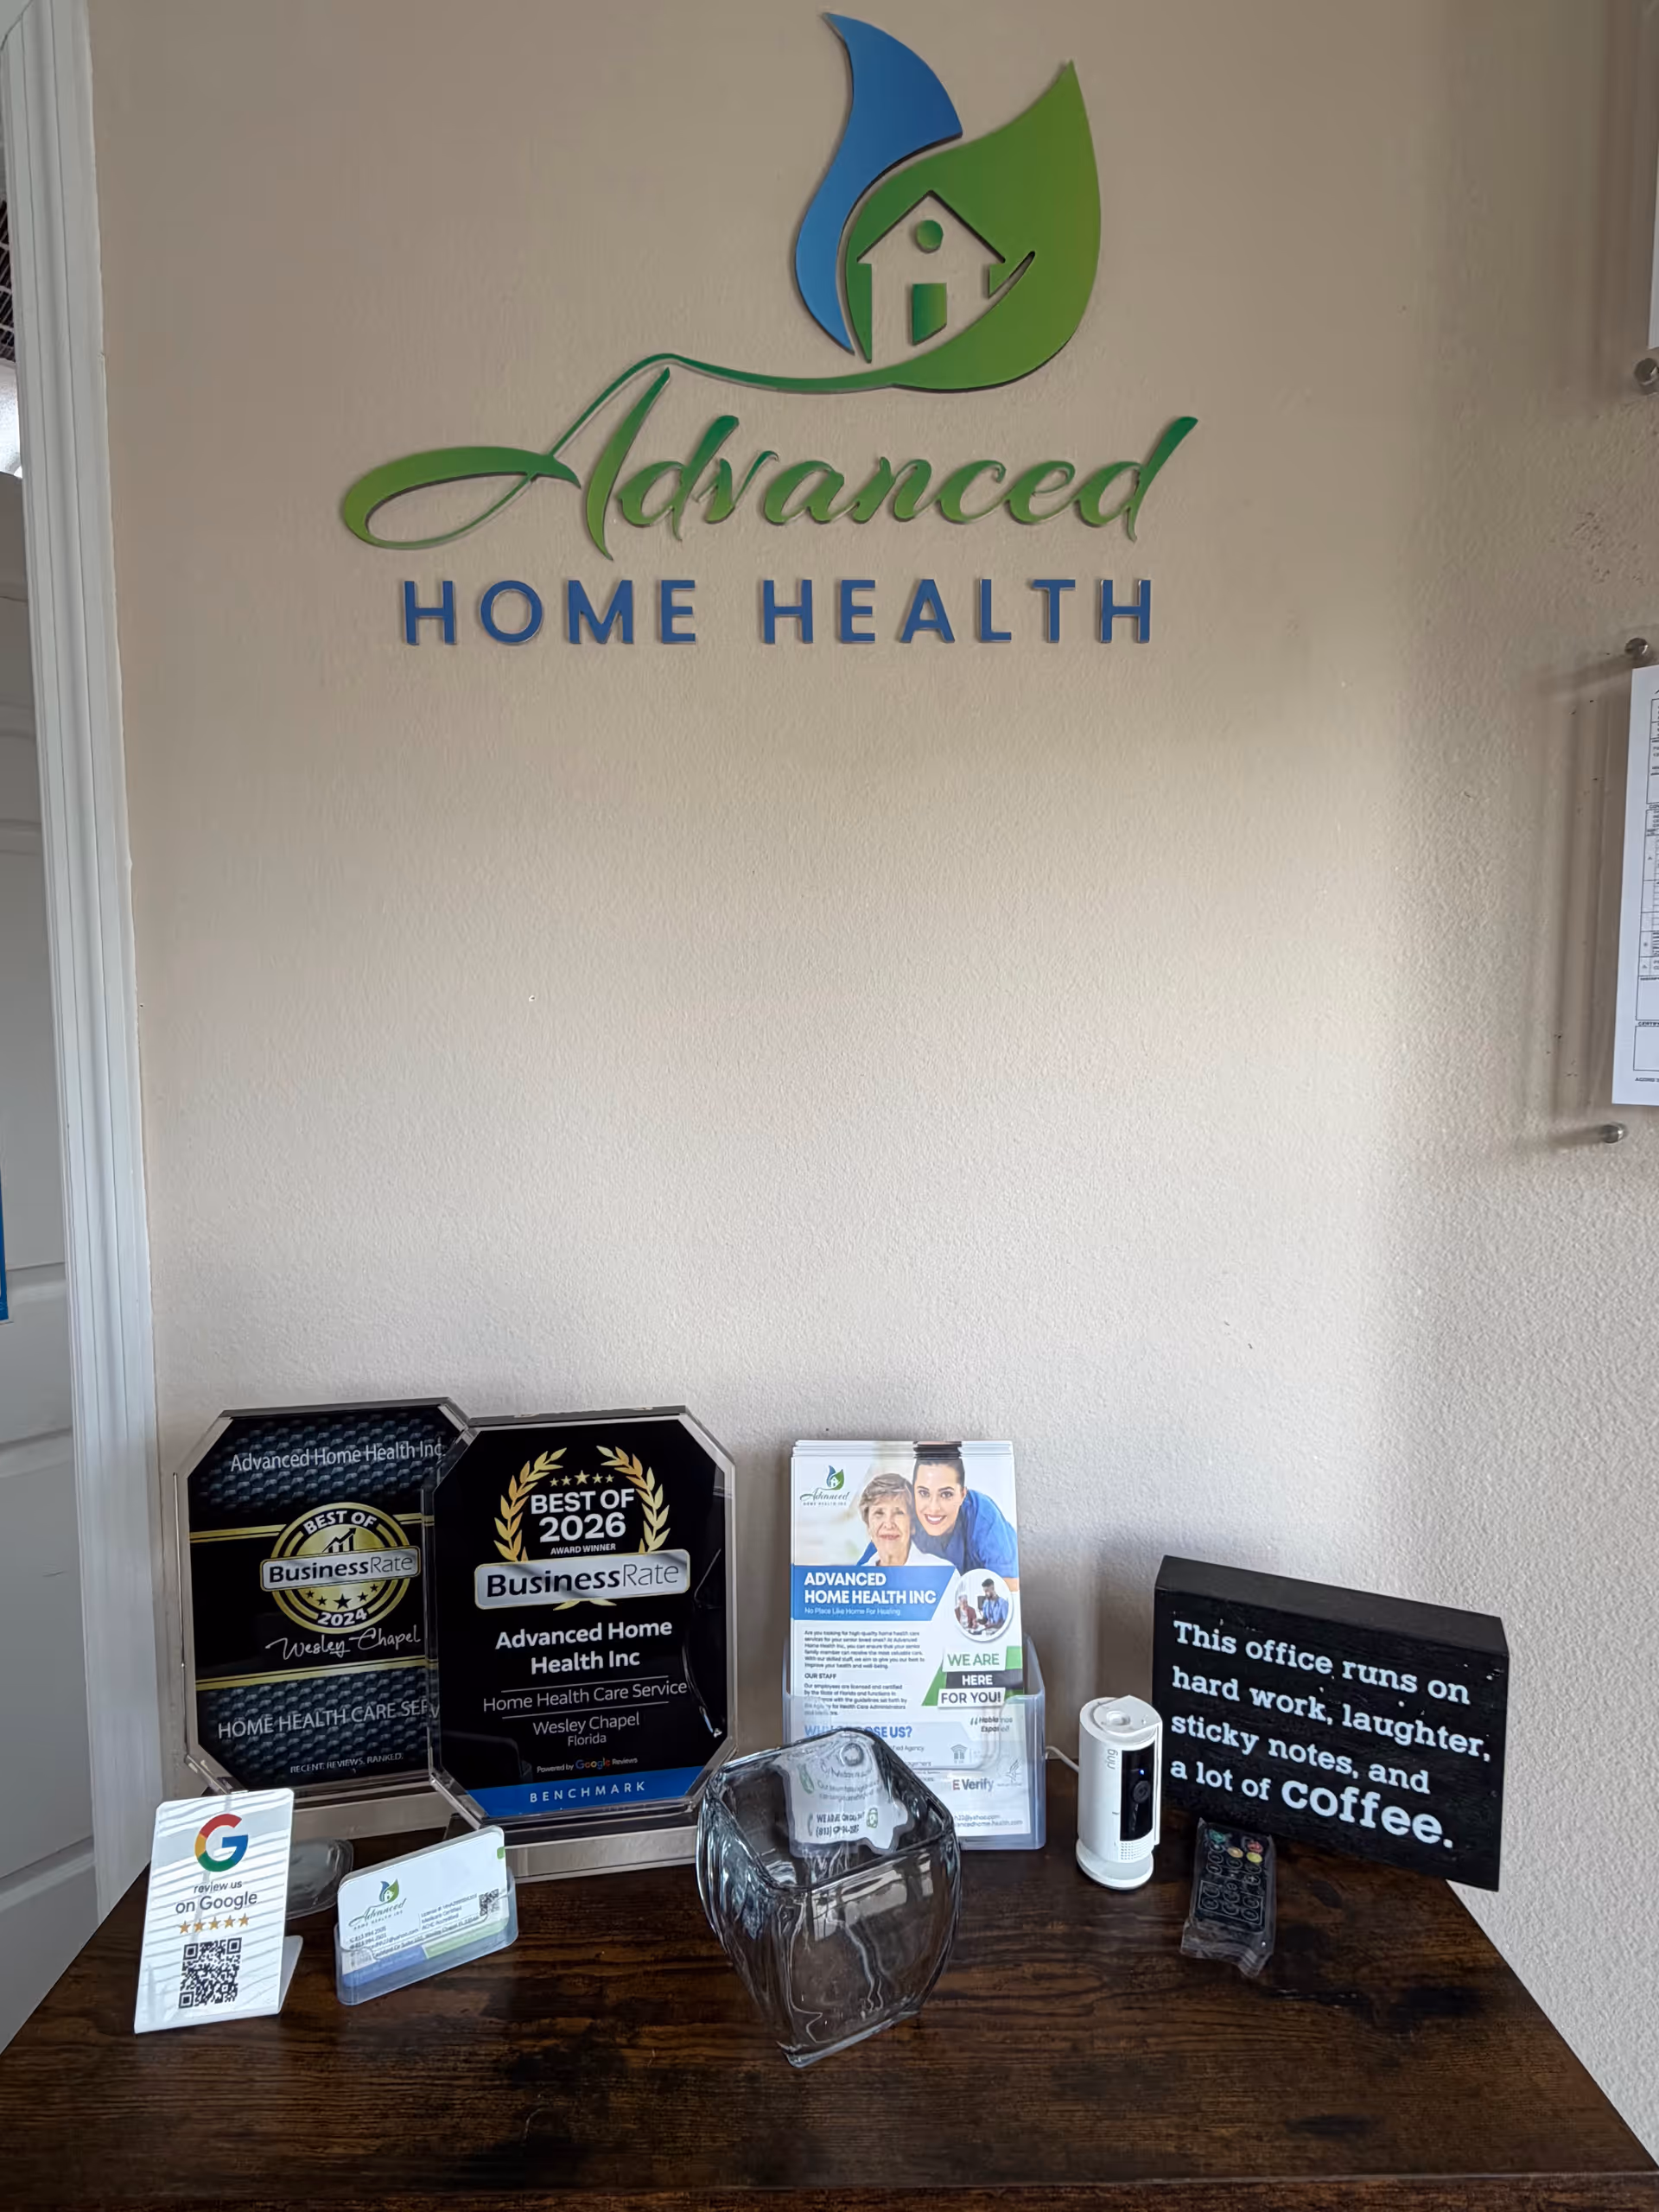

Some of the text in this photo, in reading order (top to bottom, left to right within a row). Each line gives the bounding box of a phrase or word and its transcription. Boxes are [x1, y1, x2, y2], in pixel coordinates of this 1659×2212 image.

[341, 353, 1199, 561] Advanced
[403, 578, 1154, 645] HOME HEALTH
[231, 1449, 309, 1471] Advanced
[315, 1447, 361, 1465] Home
[365, 1441, 416, 1461] Health
[531, 1488, 635, 1515] BEST OF
[799, 1487, 850, 1501] Advanced
[303, 1510, 377, 1535] BEST OF
[538, 1512, 626, 1543] 2026
[550, 1543, 616, 1555] AWARD WINNER
[270, 1556, 413, 1583] BusinessRate
[486, 1564, 679, 1598] BusinessRate
[804, 1572, 887, 1586] ADVANCED
[804, 1590, 937, 1605] HOME HEALTH INC
[317, 1608, 367, 1626] 2024
[265, 1624, 421, 1660] Wesley Chapel
[495, 1621, 672, 1649] Advanced Home
[531, 1649, 640, 1675] Health Inc
[947, 1653, 1000, 1666] WE ARE
[1173, 1620, 1471, 1706] This office runs on
[962, 1675, 993, 1686] HERE
[483, 1680, 688, 1713] Home Health Care Service
[941, 1692, 1001, 1703] FOR YOU!
[218, 1717, 274, 1739] HOME
[279, 1708, 346, 1732] HEALTH
[351, 1702, 397, 1723] CARE
[532, 1711, 640, 1735] Wesley Chapel
[1173, 1666, 1491, 1762] hard work, laughter,
[568, 1732, 607, 1747] Florida
[890, 1726, 912, 1738] US?
[537, 1763, 564, 1773] Powered
[575, 1757, 610, 1770] Google
[612, 1757, 638, 1765] Reviews
[1106, 1748, 1118, 1770] ring
[1171, 1714, 1431, 1795] sticky notes, and
[529, 1781, 645, 1802] BENCHMARK
[952, 1780, 960, 1790] E
[962, 1778, 994, 1792] Verify
[1169, 1760, 1189, 1780] a
[1195, 1761, 1233, 1793] lot
[1241, 1777, 1273, 1802] of
[194, 1880, 243, 1894] review us
[175, 1891, 257, 1914] on Google
[348, 1897, 407, 1926] Advanced
